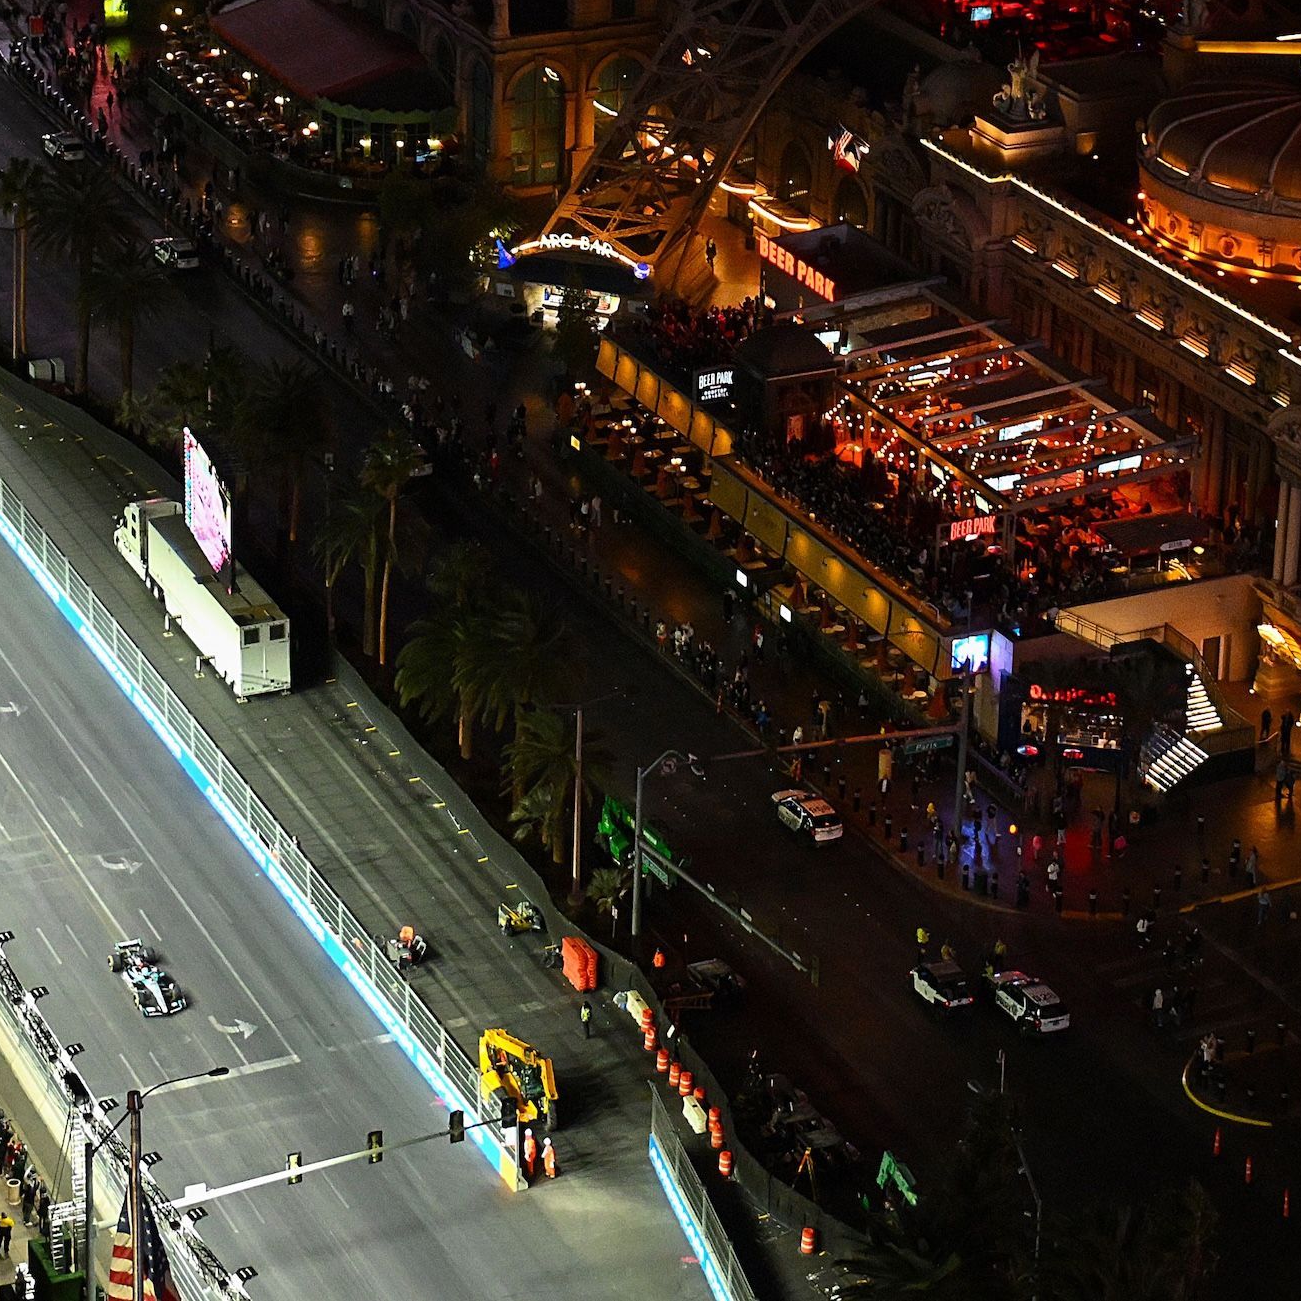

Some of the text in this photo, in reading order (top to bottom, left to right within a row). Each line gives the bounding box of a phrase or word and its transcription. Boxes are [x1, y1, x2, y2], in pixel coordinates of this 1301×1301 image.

[579, 235, 611, 258] BAR
[759, 235, 835, 302] BEER PARK
[699, 370, 733, 390] BEER PARK
[950, 515, 996, 540] BEER PARK
